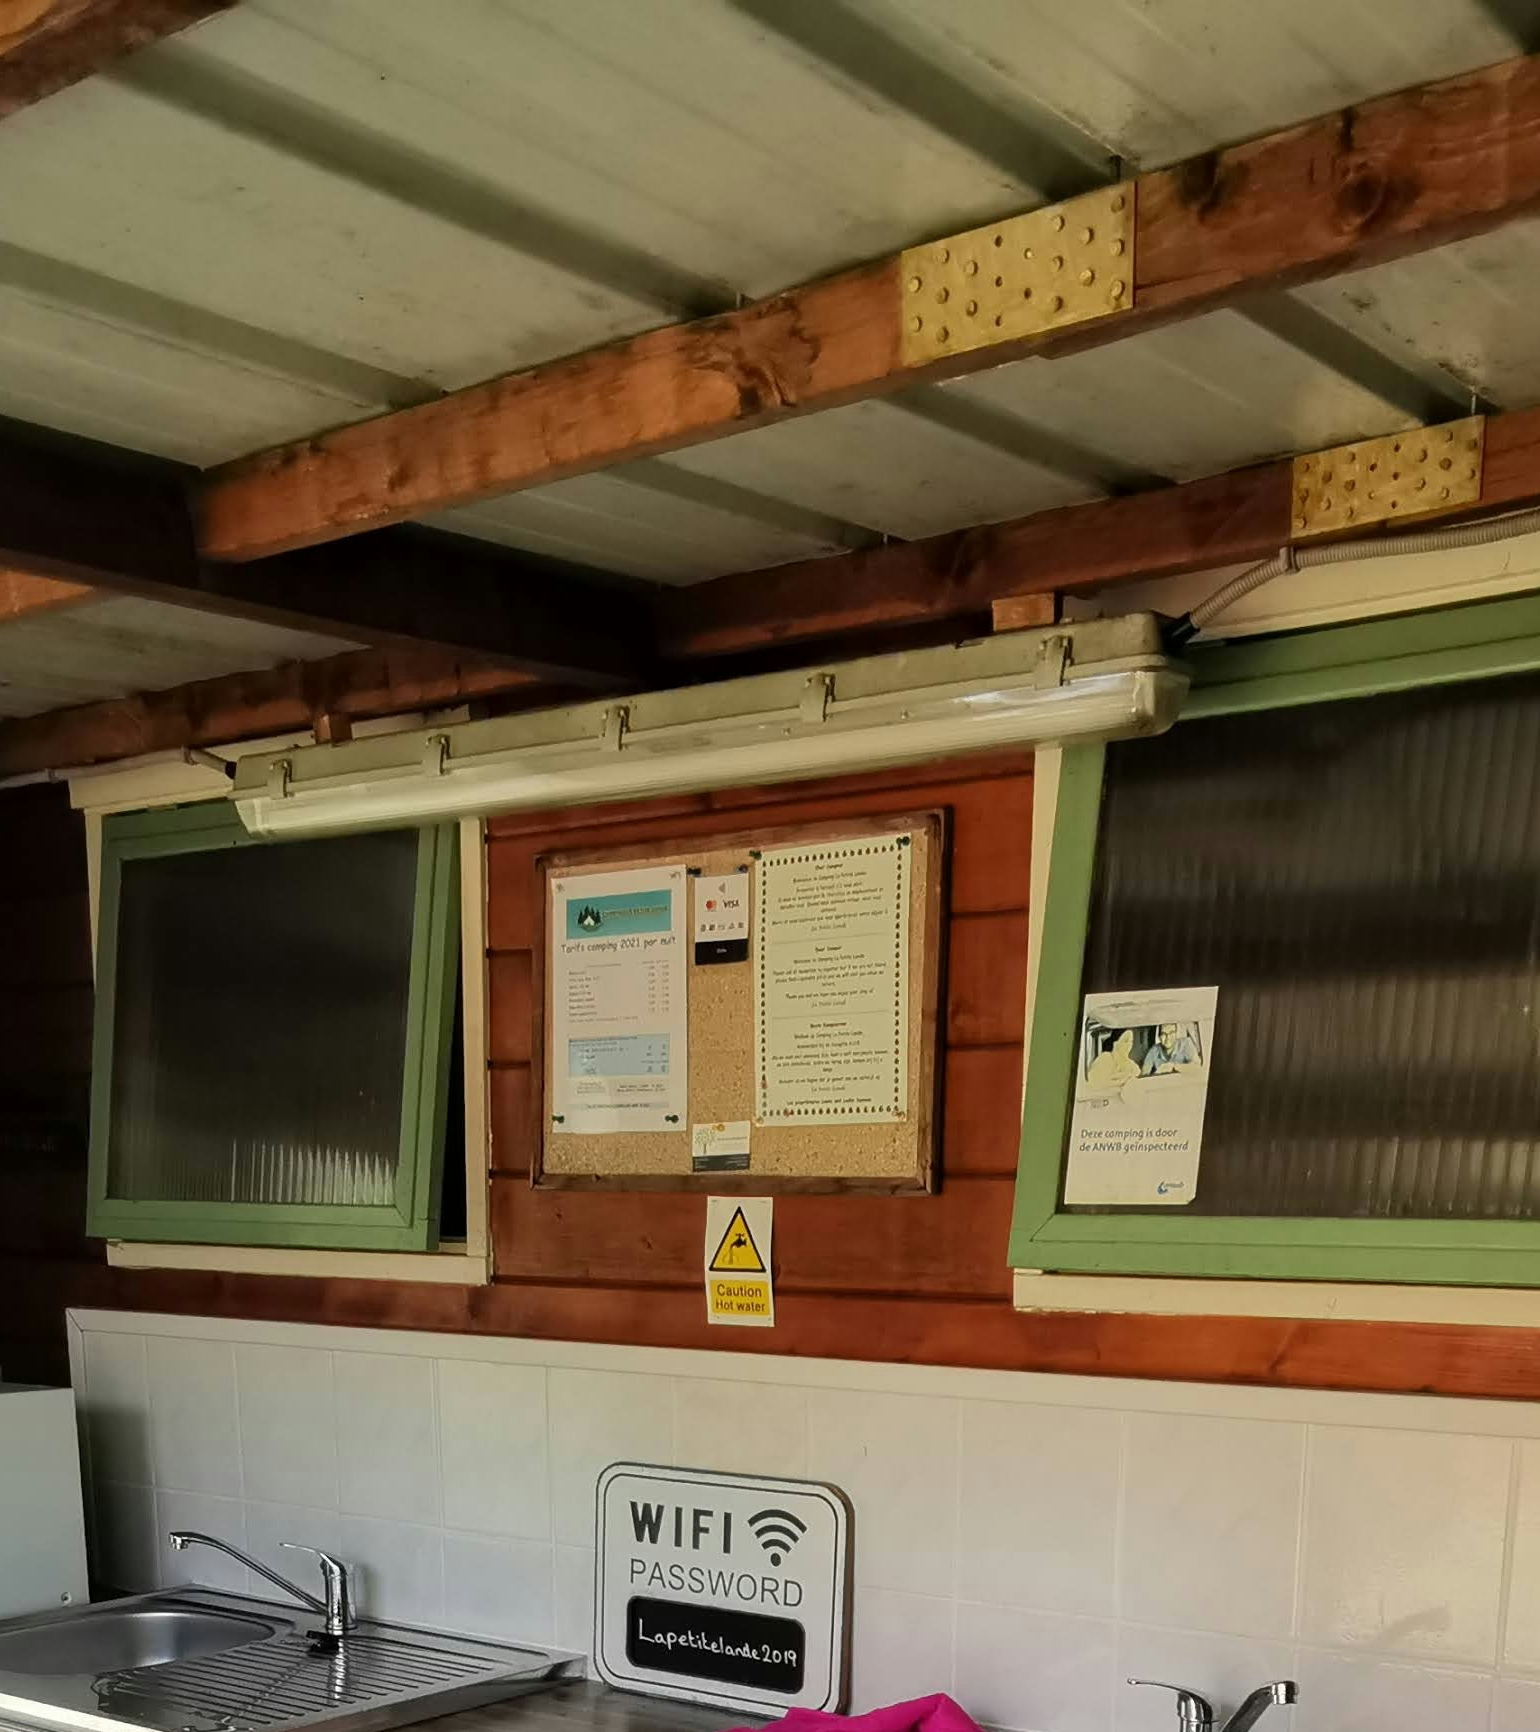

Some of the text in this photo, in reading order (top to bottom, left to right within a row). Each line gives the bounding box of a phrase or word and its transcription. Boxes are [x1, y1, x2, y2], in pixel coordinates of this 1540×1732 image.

[620, 937, 640, 949] 2021
[1080, 1128, 1179, 1141] Deze camping is door
[1079, 1142, 1091, 1152] de
[1092, 1142, 1122, 1152] ANWB
[716, 1284, 762, 1298] Caution
[716, 1300, 766, 1312] Hot water
[629, 1500, 732, 1554] WIFI
[629, 1558, 803, 1607] PASSWORD
[638, 1618, 798, 1667] Lapetitelande2019
